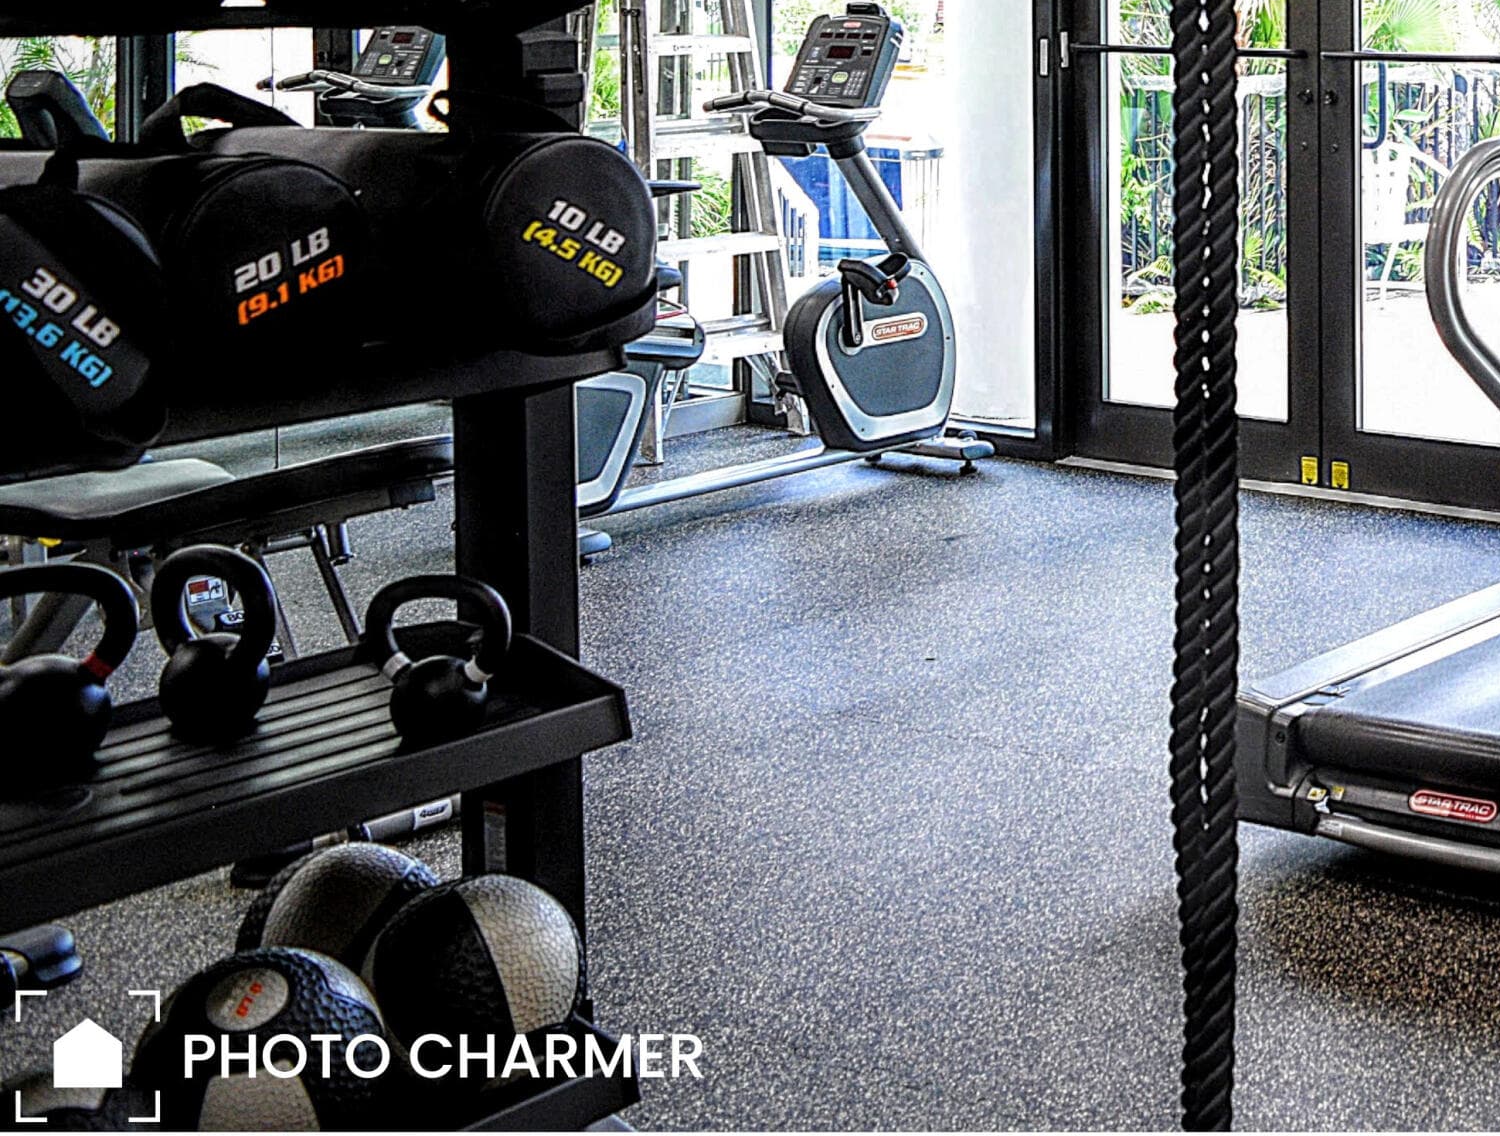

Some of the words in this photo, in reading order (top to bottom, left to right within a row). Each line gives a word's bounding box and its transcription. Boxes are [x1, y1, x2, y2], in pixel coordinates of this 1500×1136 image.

[522, 221, 581, 260] (4.5
[578, 251, 624, 287] KG)
[548, 200, 587, 231] 10
[584, 221, 626, 255] LB
[234, 251, 281, 293] 20
[290, 226, 330, 266] LB
[21, 266, 77, 314] 30
[71, 305, 120, 348] LB
[237, 281, 289, 325] (9.1
[299, 255, 345, 294] KG)
[876, 324, 897, 336] STAR
[60, 340, 113, 388] KG)
[1453, 800, 1491, 815] TRAC
